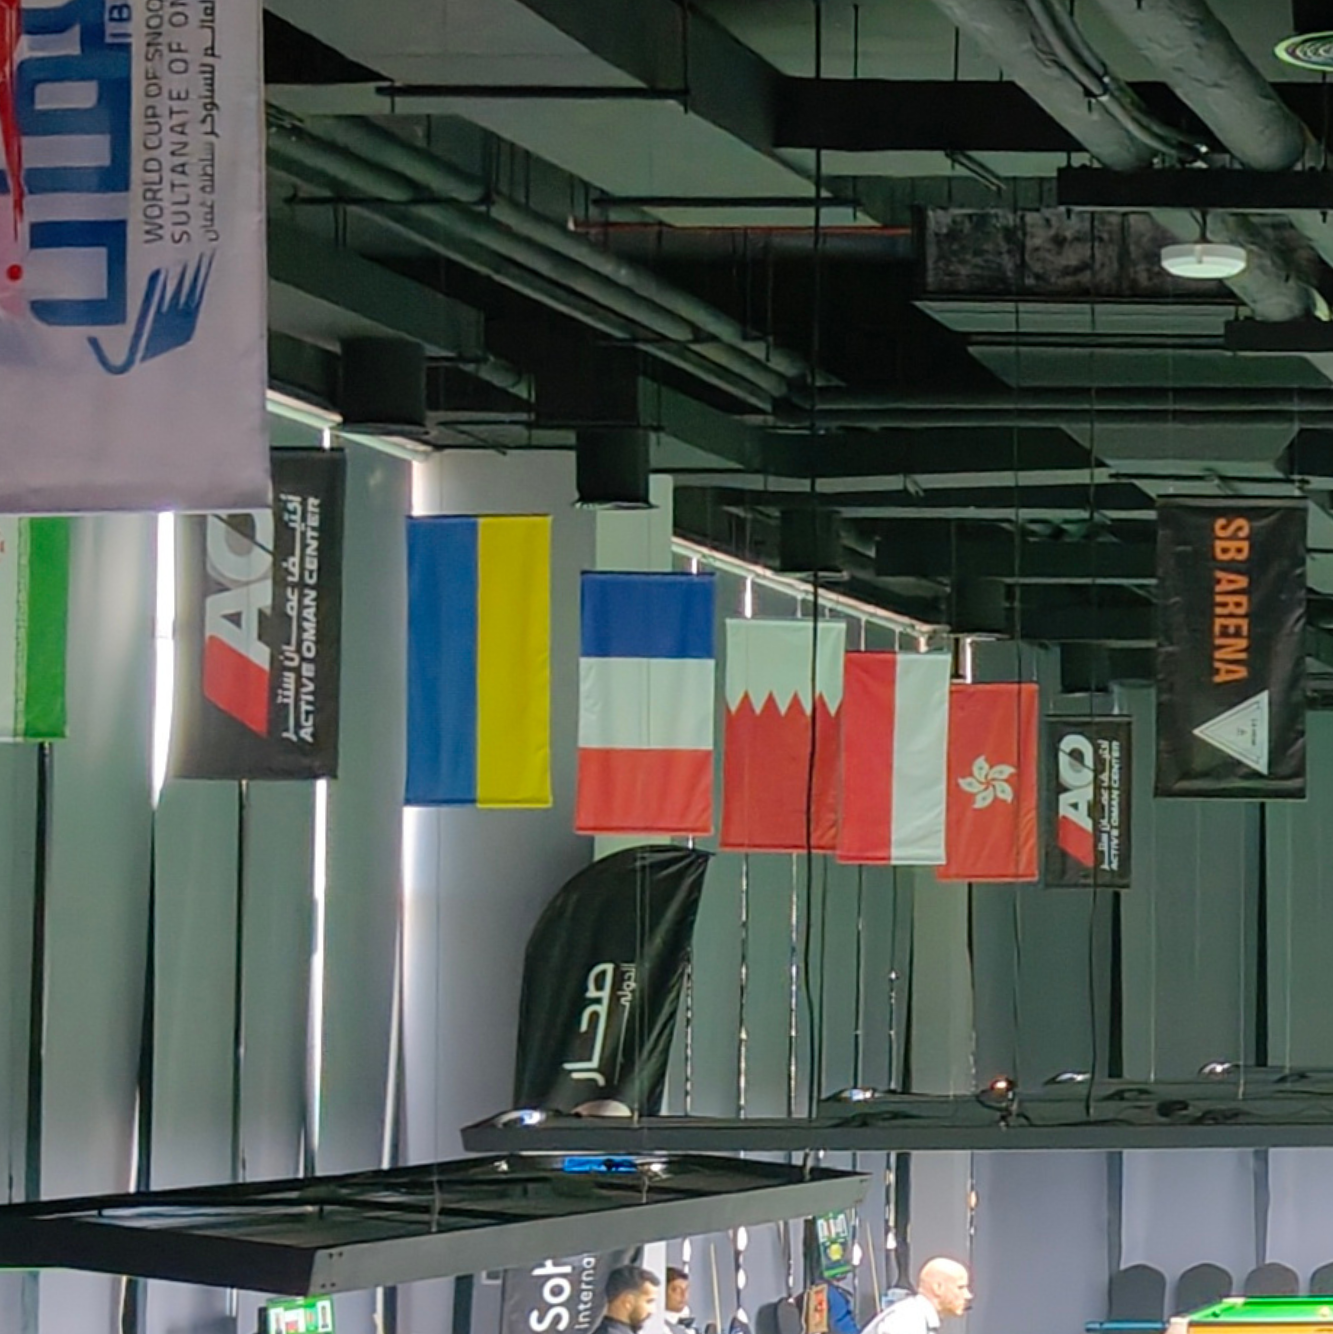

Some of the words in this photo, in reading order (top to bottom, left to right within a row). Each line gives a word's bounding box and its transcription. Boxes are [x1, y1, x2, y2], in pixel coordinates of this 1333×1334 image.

[143, 69, 164, 98] OF
[168, 40, 189, 76] OF
[143, 106, 164, 151] CUP
[143, 157, 165, 244] WORLD
[167, 88, 191, 244] SULTANATE
[304, 496, 321, 585] CENTER
[1213, 515, 1251, 562] SB
[302, 588, 318, 660] OMAN
[1212, 567, 1251, 685] ARENA
[300, 661, 316, 744] ACTIVE
[1111, 739, 1122, 788] CENTER
[1110, 788, 1121, 827] OMAN
[562, 962, 616, 1088] صحار
